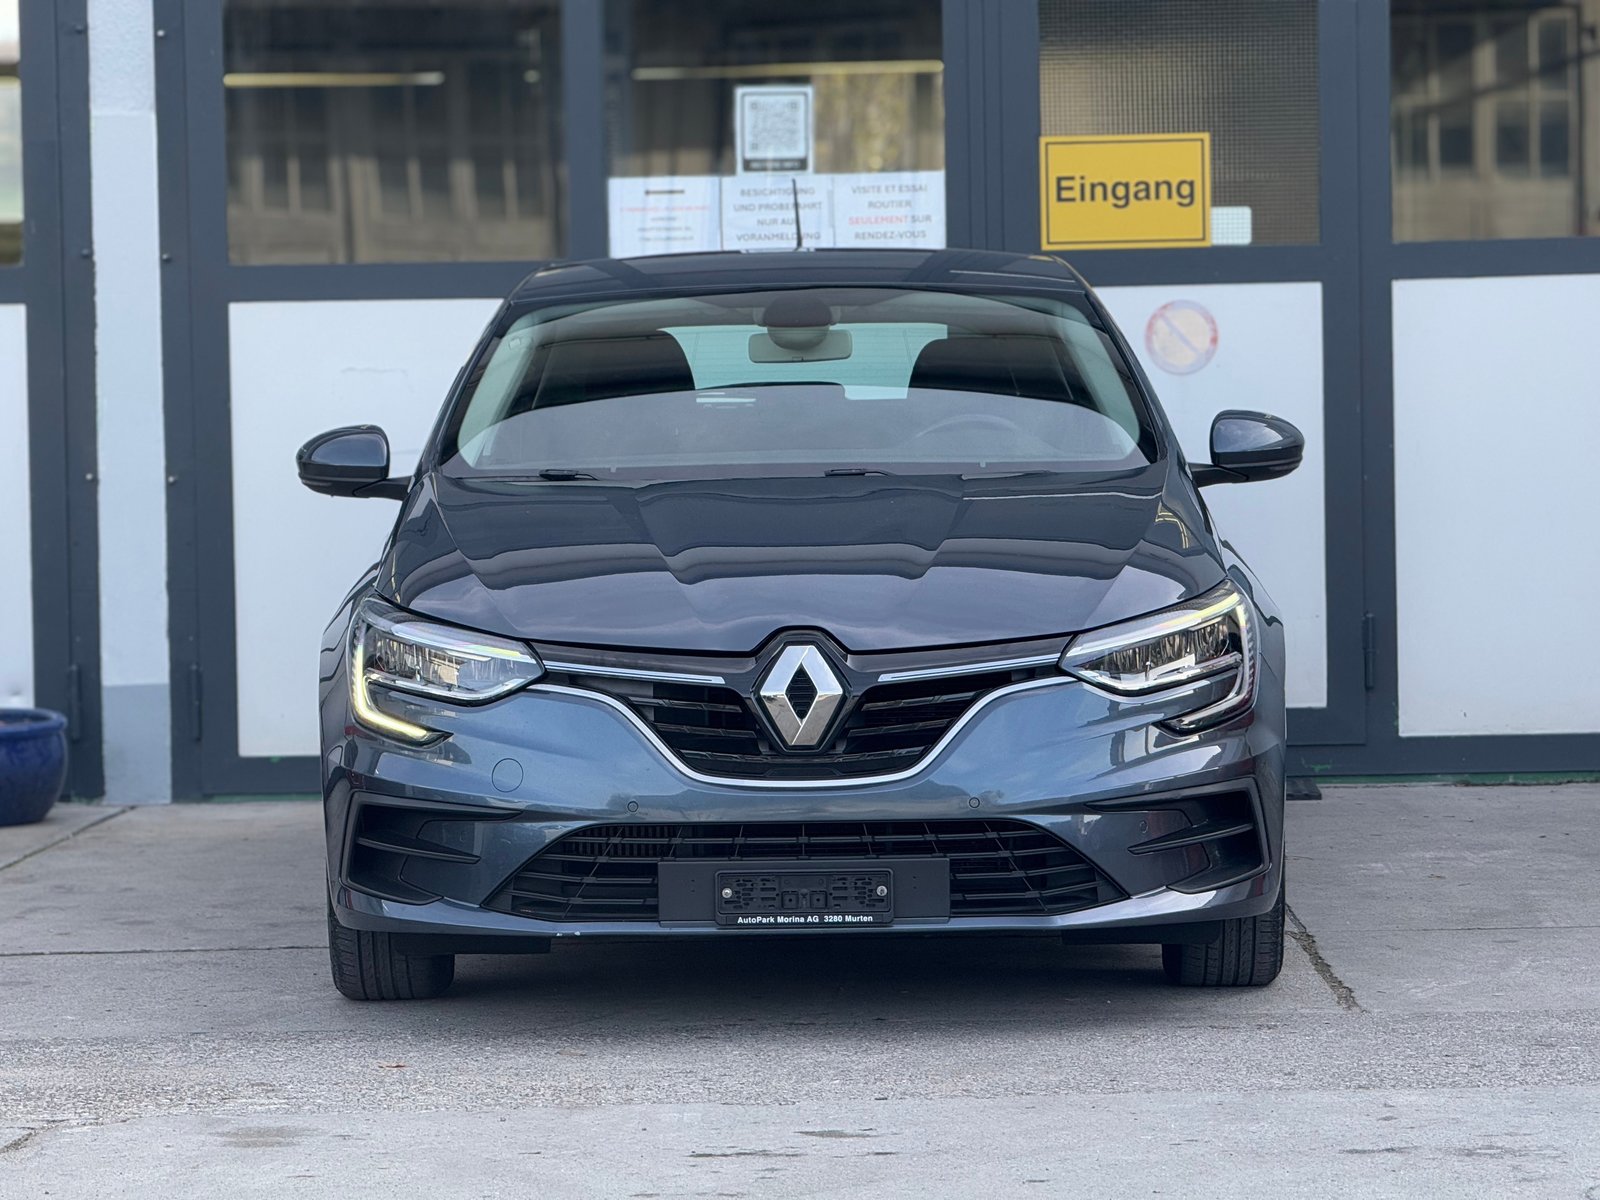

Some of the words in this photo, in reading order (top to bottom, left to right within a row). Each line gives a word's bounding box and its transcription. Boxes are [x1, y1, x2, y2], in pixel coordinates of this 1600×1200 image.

[851, 185, 881, 194] VISITE
[884, 184, 896, 193] ET
[898, 184, 928, 193] ESSAI
[1055, 175, 1195, 209] Eingang
[733, 203, 756, 212] UND
[758, 202, 822, 211] PROBEAHRT
[867, 200, 912, 209] ROUTIER
[757, 218, 778, 226] NUR
[848, 215, 908, 225] SEULEMENT
[911, 214, 932, 223] SUR
[854, 231, 927, 240] RENDEZ-VOUS
[737, 916, 775, 924] AutoPark
[806, 915, 819, 923] AG
[823, 915, 843, 923] 3280
